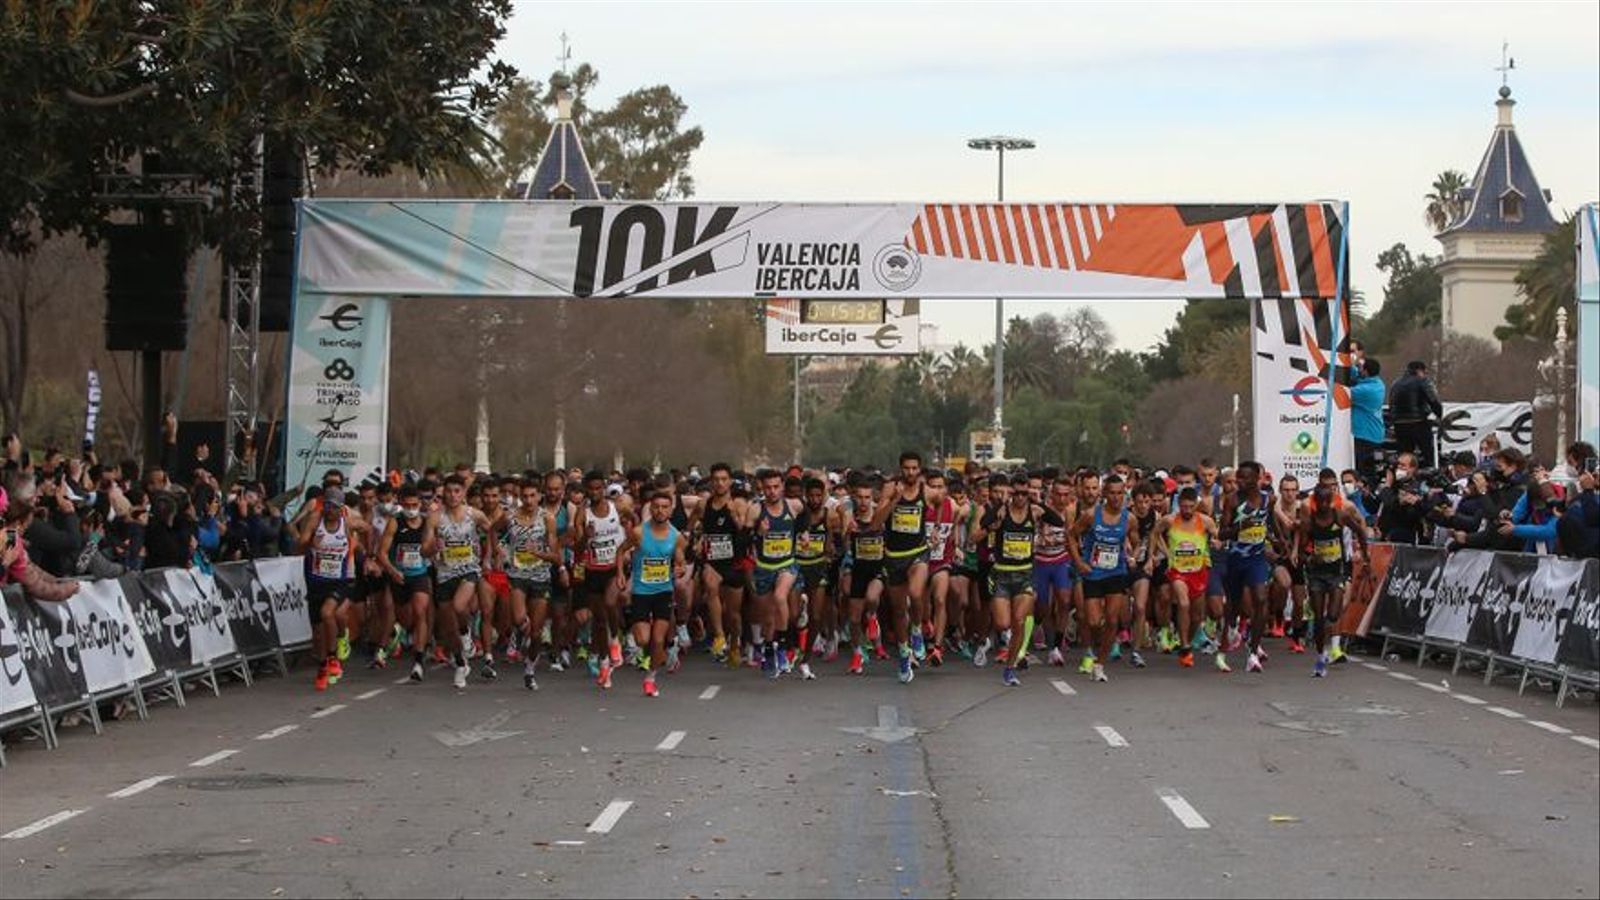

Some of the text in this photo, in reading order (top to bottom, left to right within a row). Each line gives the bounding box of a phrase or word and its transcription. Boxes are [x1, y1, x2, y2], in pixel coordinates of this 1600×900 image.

[570, 204, 739, 297] 10K
[757, 243, 861, 266] VALENCIA
[755, 268, 861, 291] IBERCAJA
[319, 338, 363, 349] iberCaja
[782, 327, 857, 345] iberCaja
[1279, 414, 1326, 426] iberCaja
